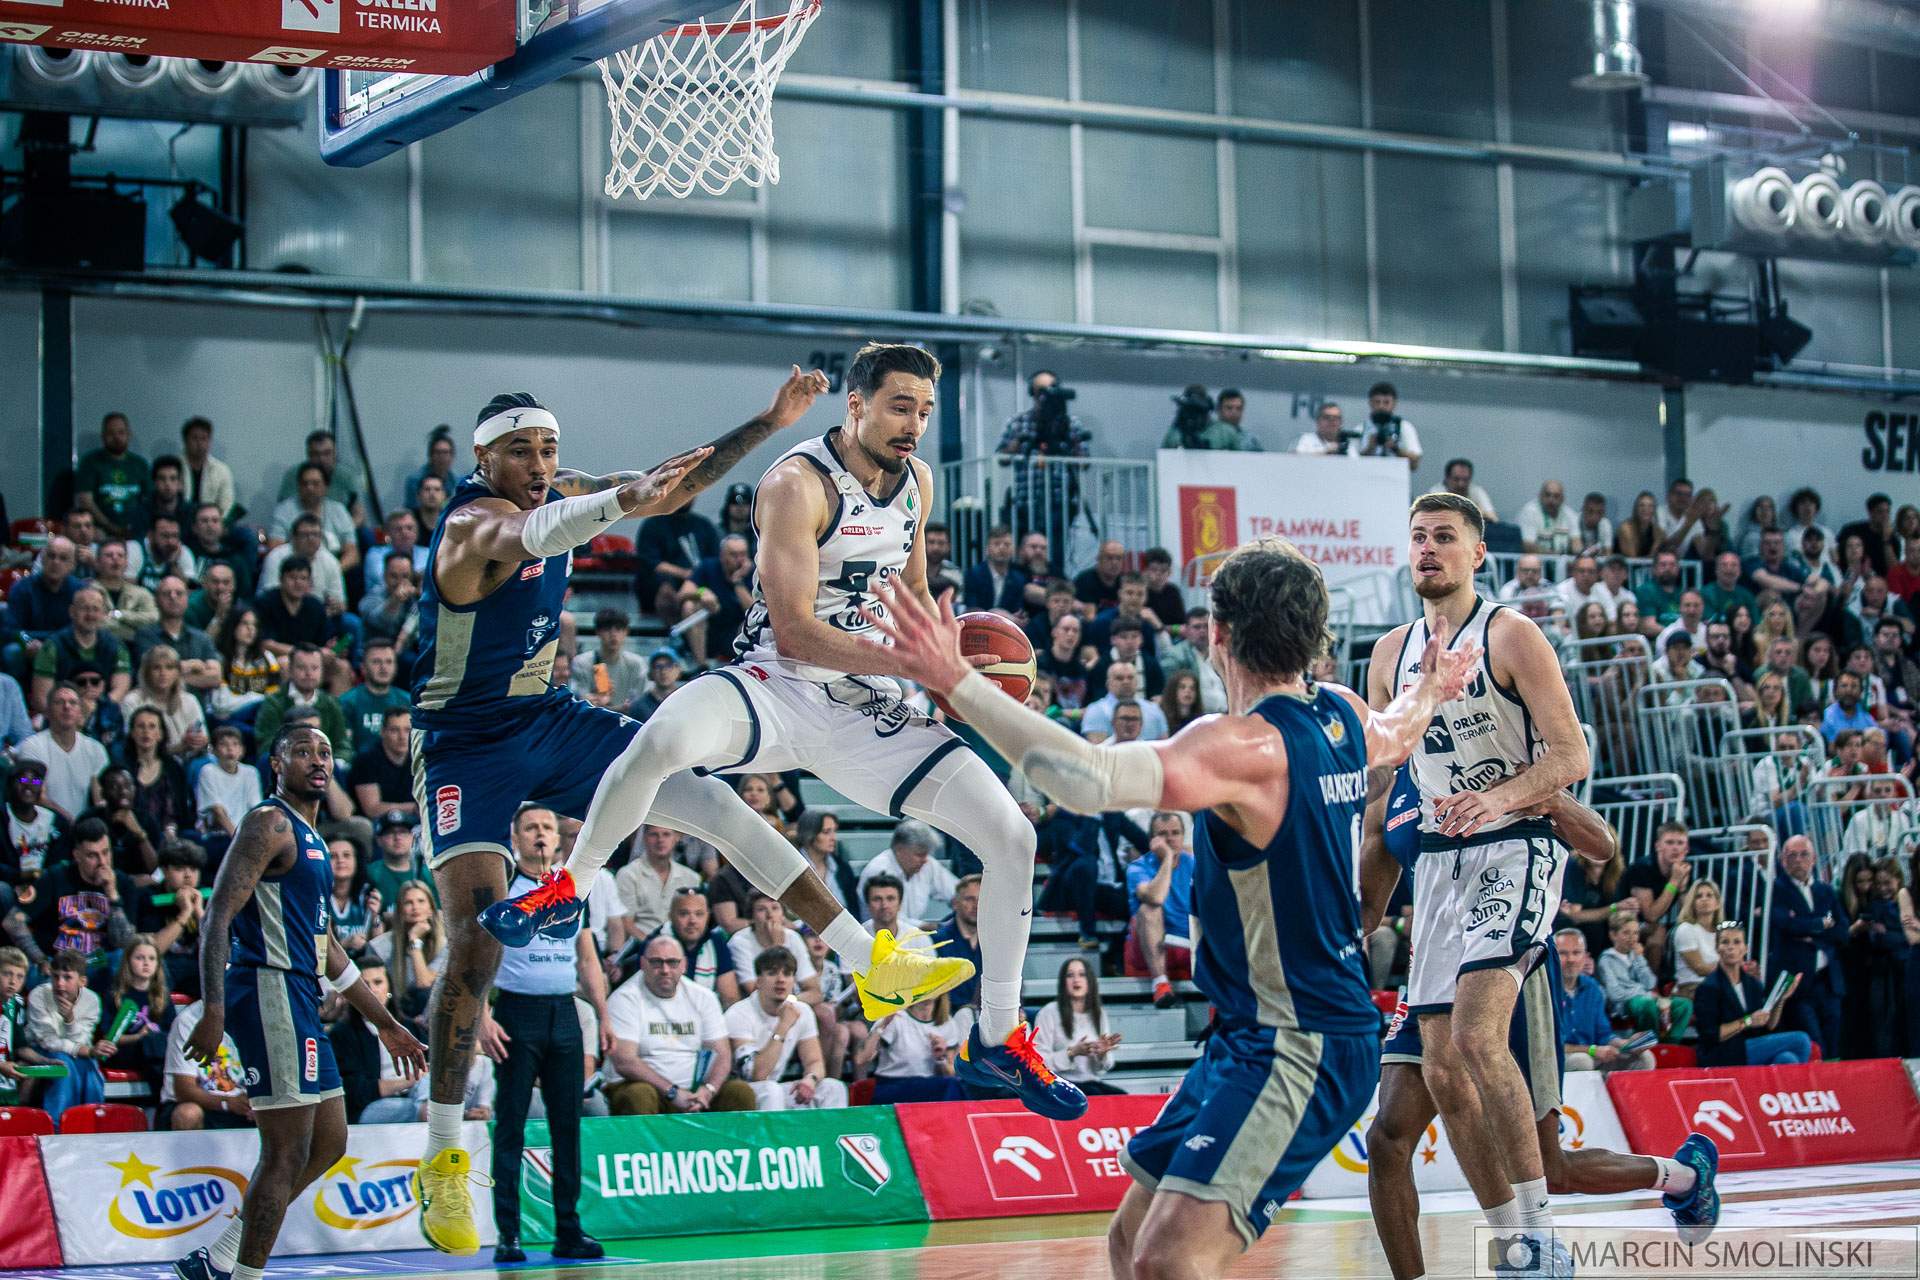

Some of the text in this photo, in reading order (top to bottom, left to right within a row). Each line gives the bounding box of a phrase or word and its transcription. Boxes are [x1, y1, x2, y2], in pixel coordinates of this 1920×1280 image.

[355, 11, 442, 34] TERMIKA
[55, 36, 146, 49] TERMIKA
[60, 31, 148, 44] ORLEN
[327, 60, 408, 70] TERMIKA
[333, 55, 417, 65] ORLEN
[1249, 515, 1361, 539] TRAMWAJE
[1453, 711, 1491, 731] ORLEN
[1457, 723, 1498, 742] TERMIKA
[528, 953, 552, 962] Bank
[1759, 1090, 1841, 1117] ORLEN
[1768, 1116, 1857, 1139] TERMIKA
[597, 1145, 824, 1198] LEGIAKOSZ.COM
[133, 1178, 225, 1225] LOTTO
[336, 1171, 416, 1216] LOTT
